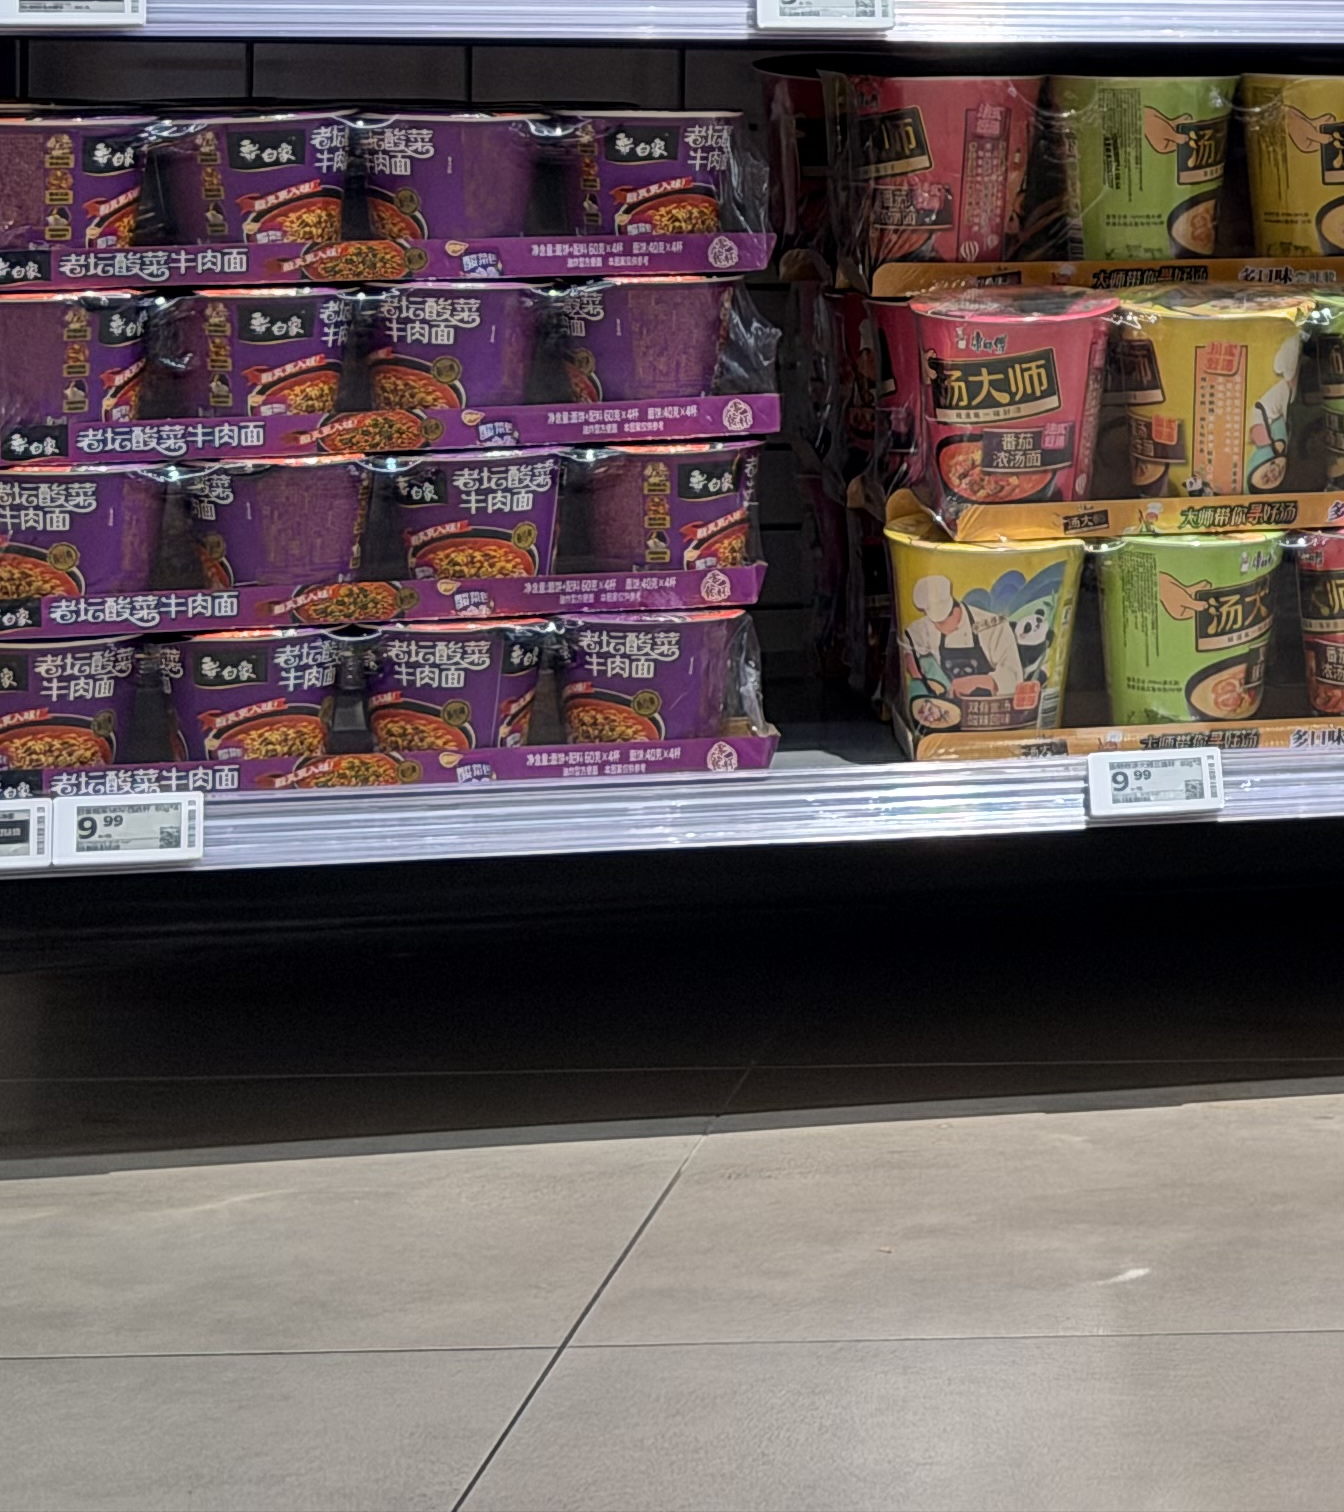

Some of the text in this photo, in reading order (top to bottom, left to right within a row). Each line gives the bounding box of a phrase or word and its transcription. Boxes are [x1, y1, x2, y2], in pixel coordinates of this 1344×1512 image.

[58, 249, 248, 281] 老坛酸菜牛肉面
[386, 321, 455, 345] 牛肉面
[75, 422, 265, 455] 老坛酸菜牛肉面
[1001, 434, 1034, 450] 番茄
[991, 450, 1043, 467] 浓汤面
[452, 461, 555, 493] 老坛酸菜
[459, 489, 535, 515] 牛肉面
[1180, 501, 1298, 529] 大师带你寻好汤
[49, 592, 240, 627] 老坛酸菜牛肉面
[387, 639, 492, 671] 老坛酸菜
[578, 630, 681, 662] 老坛酸菜
[34, 648, 136, 680] 老坛酸菜
[393, 664, 466, 689] 牛肉面
[583, 657, 656, 679] 牛肉面
[40, 675, 116, 701] 牛肉面
[50, 766, 240, 796] 老坛酸菜牛肉面
[1111, 770, 1152, 792] 9 99
[77, 815, 124, 840] 9 99
